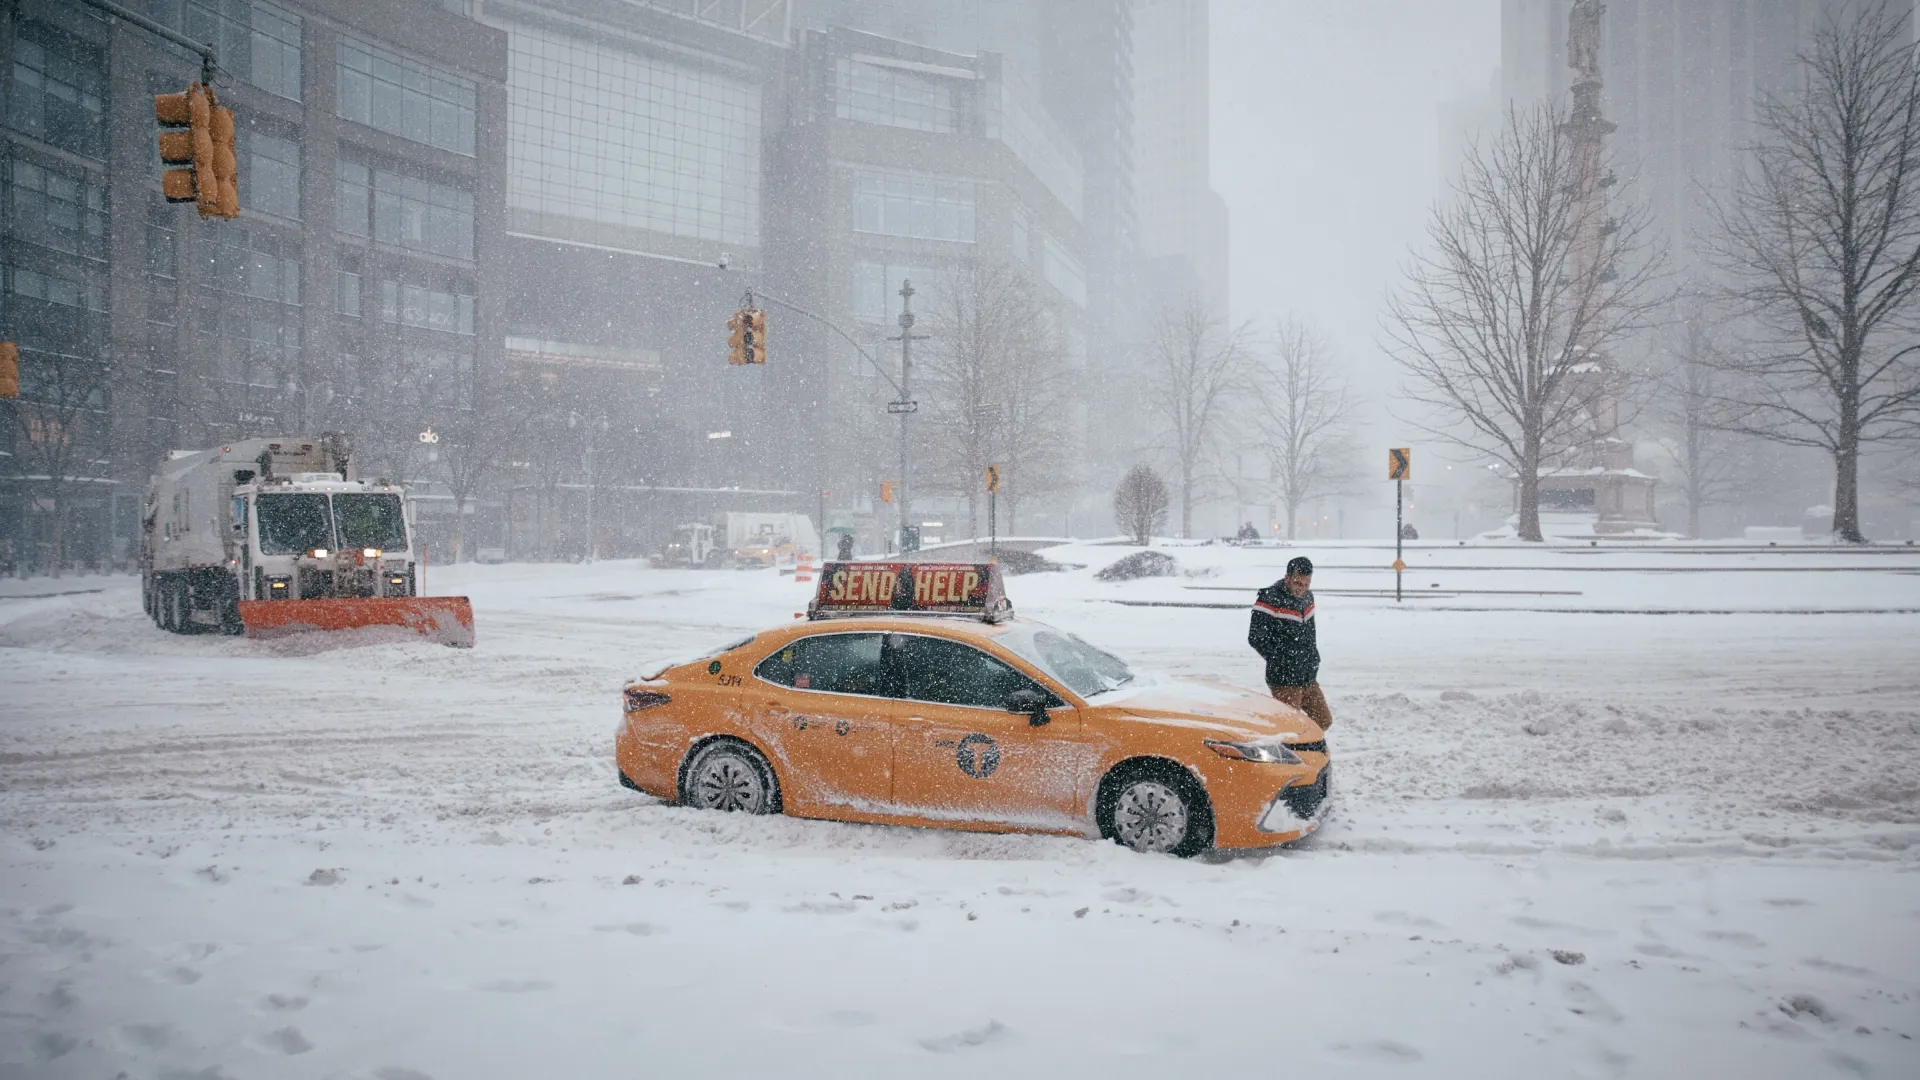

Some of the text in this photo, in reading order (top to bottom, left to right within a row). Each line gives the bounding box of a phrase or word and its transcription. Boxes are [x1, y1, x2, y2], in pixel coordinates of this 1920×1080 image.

[420, 427, 439, 443] alo
[830, 570, 979, 602] SEND HELP
